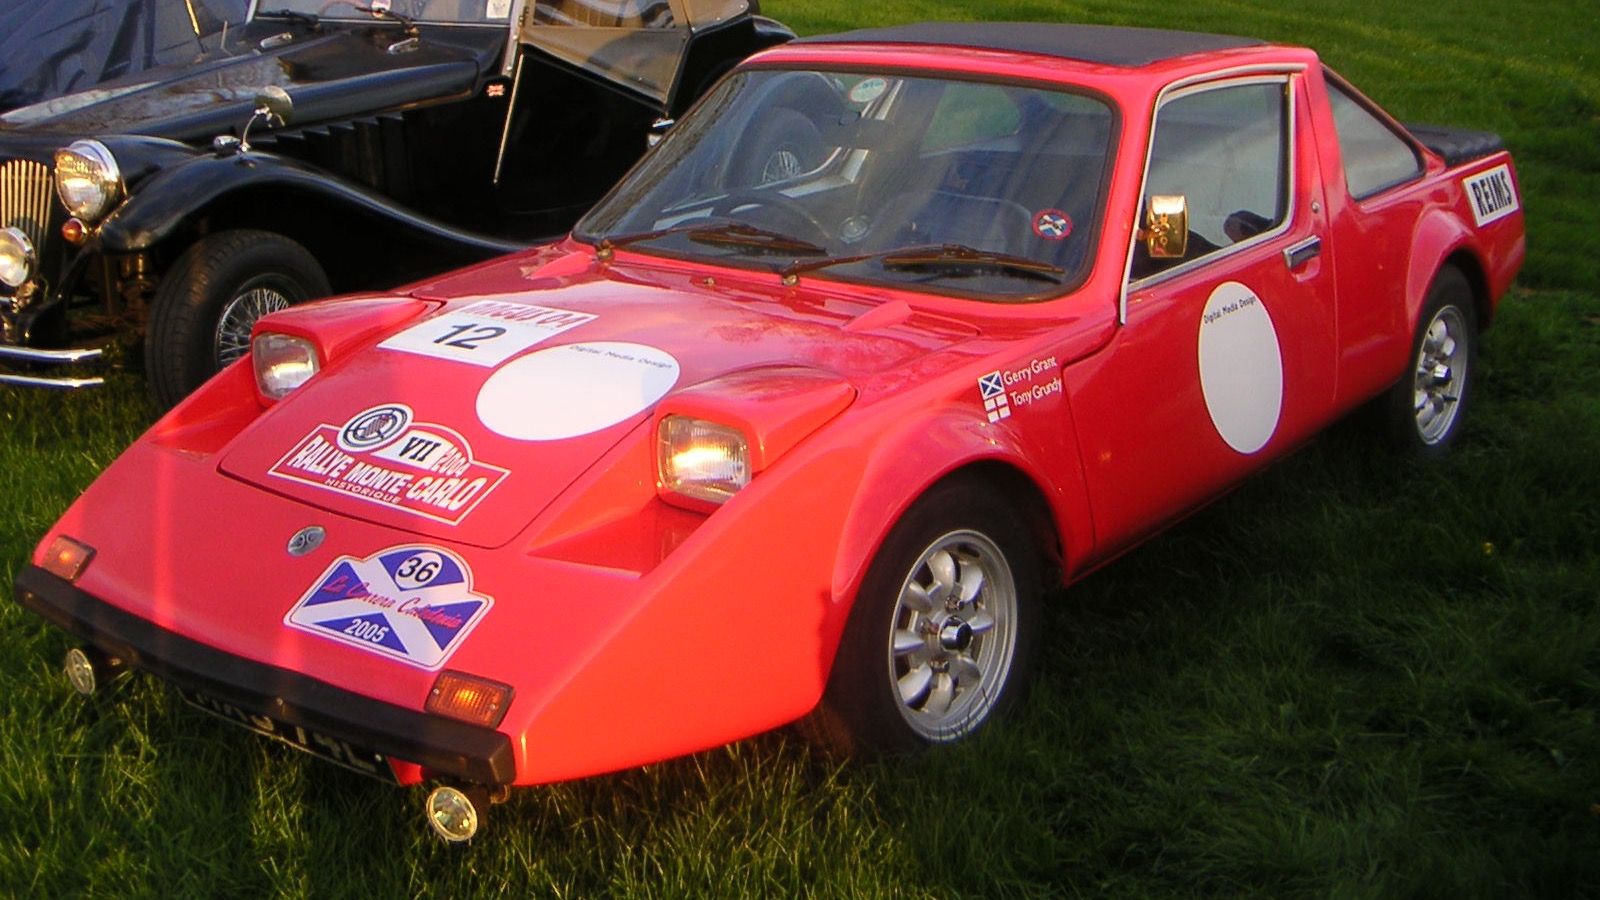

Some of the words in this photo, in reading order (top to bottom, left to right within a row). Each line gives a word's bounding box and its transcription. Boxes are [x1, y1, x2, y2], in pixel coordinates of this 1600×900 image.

[1470, 170, 1513, 217] REIMS
[1203, 309, 1221, 325] Digital
[1222, 302, 1239, 315] Media
[1238, 295, 1257, 308] Design
[432, 322, 507, 350] 12
[604, 351, 634, 361] Media
[637, 358, 673, 369] Design
[1003, 365, 1032, 386] Gerry
[1030, 356, 1057, 374] Grant
[1009, 390, 1033, 407] Tony
[1031, 377, 1063, 399] Grundy
[398, 436, 442, 463] VII
[286, 433, 355, 479] RALLYE
[343, 461, 488, 512] MONTE-CARLO
[324, 478, 402, 505] HISTORIQUE
[397, 556, 440, 583] 36
[343, 617, 390, 643] 2005
